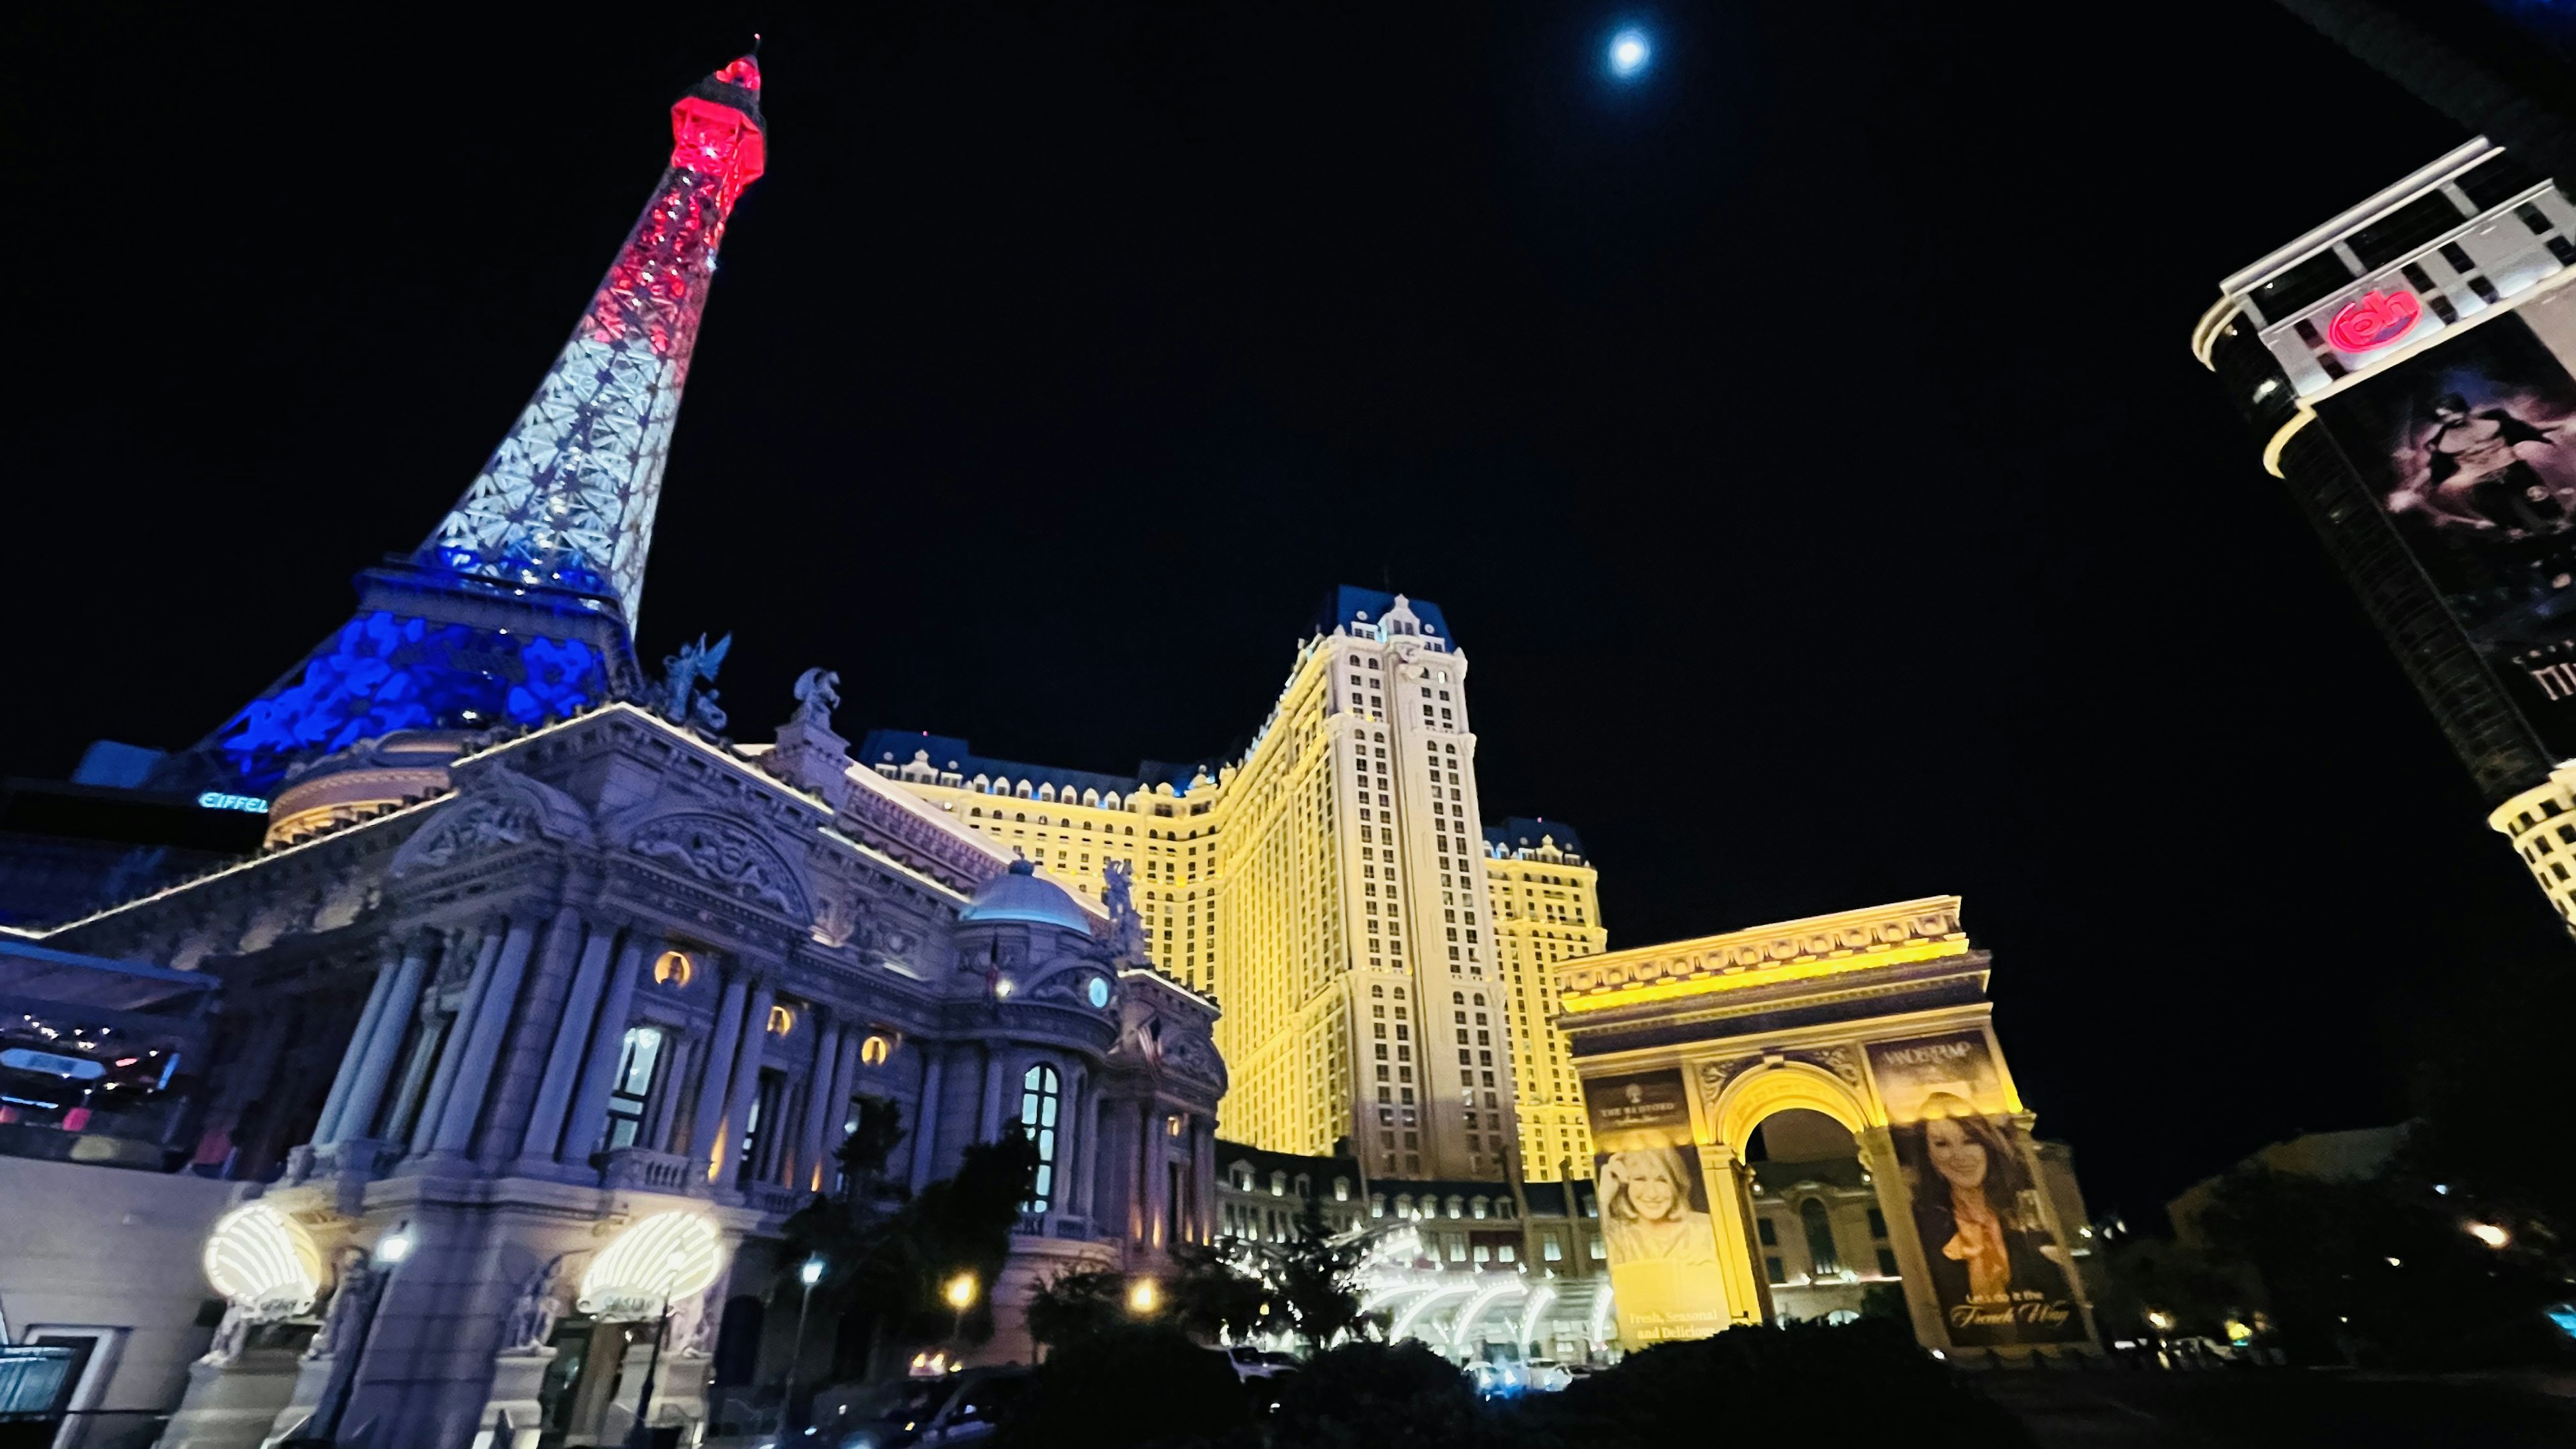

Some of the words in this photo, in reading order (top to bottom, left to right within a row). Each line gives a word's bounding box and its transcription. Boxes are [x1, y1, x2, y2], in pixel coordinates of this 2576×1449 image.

[199, 792, 268, 813] EIFFEL
[1665, 1308, 1718, 1323] Seasonal
[1637, 1326, 1660, 1339] and
